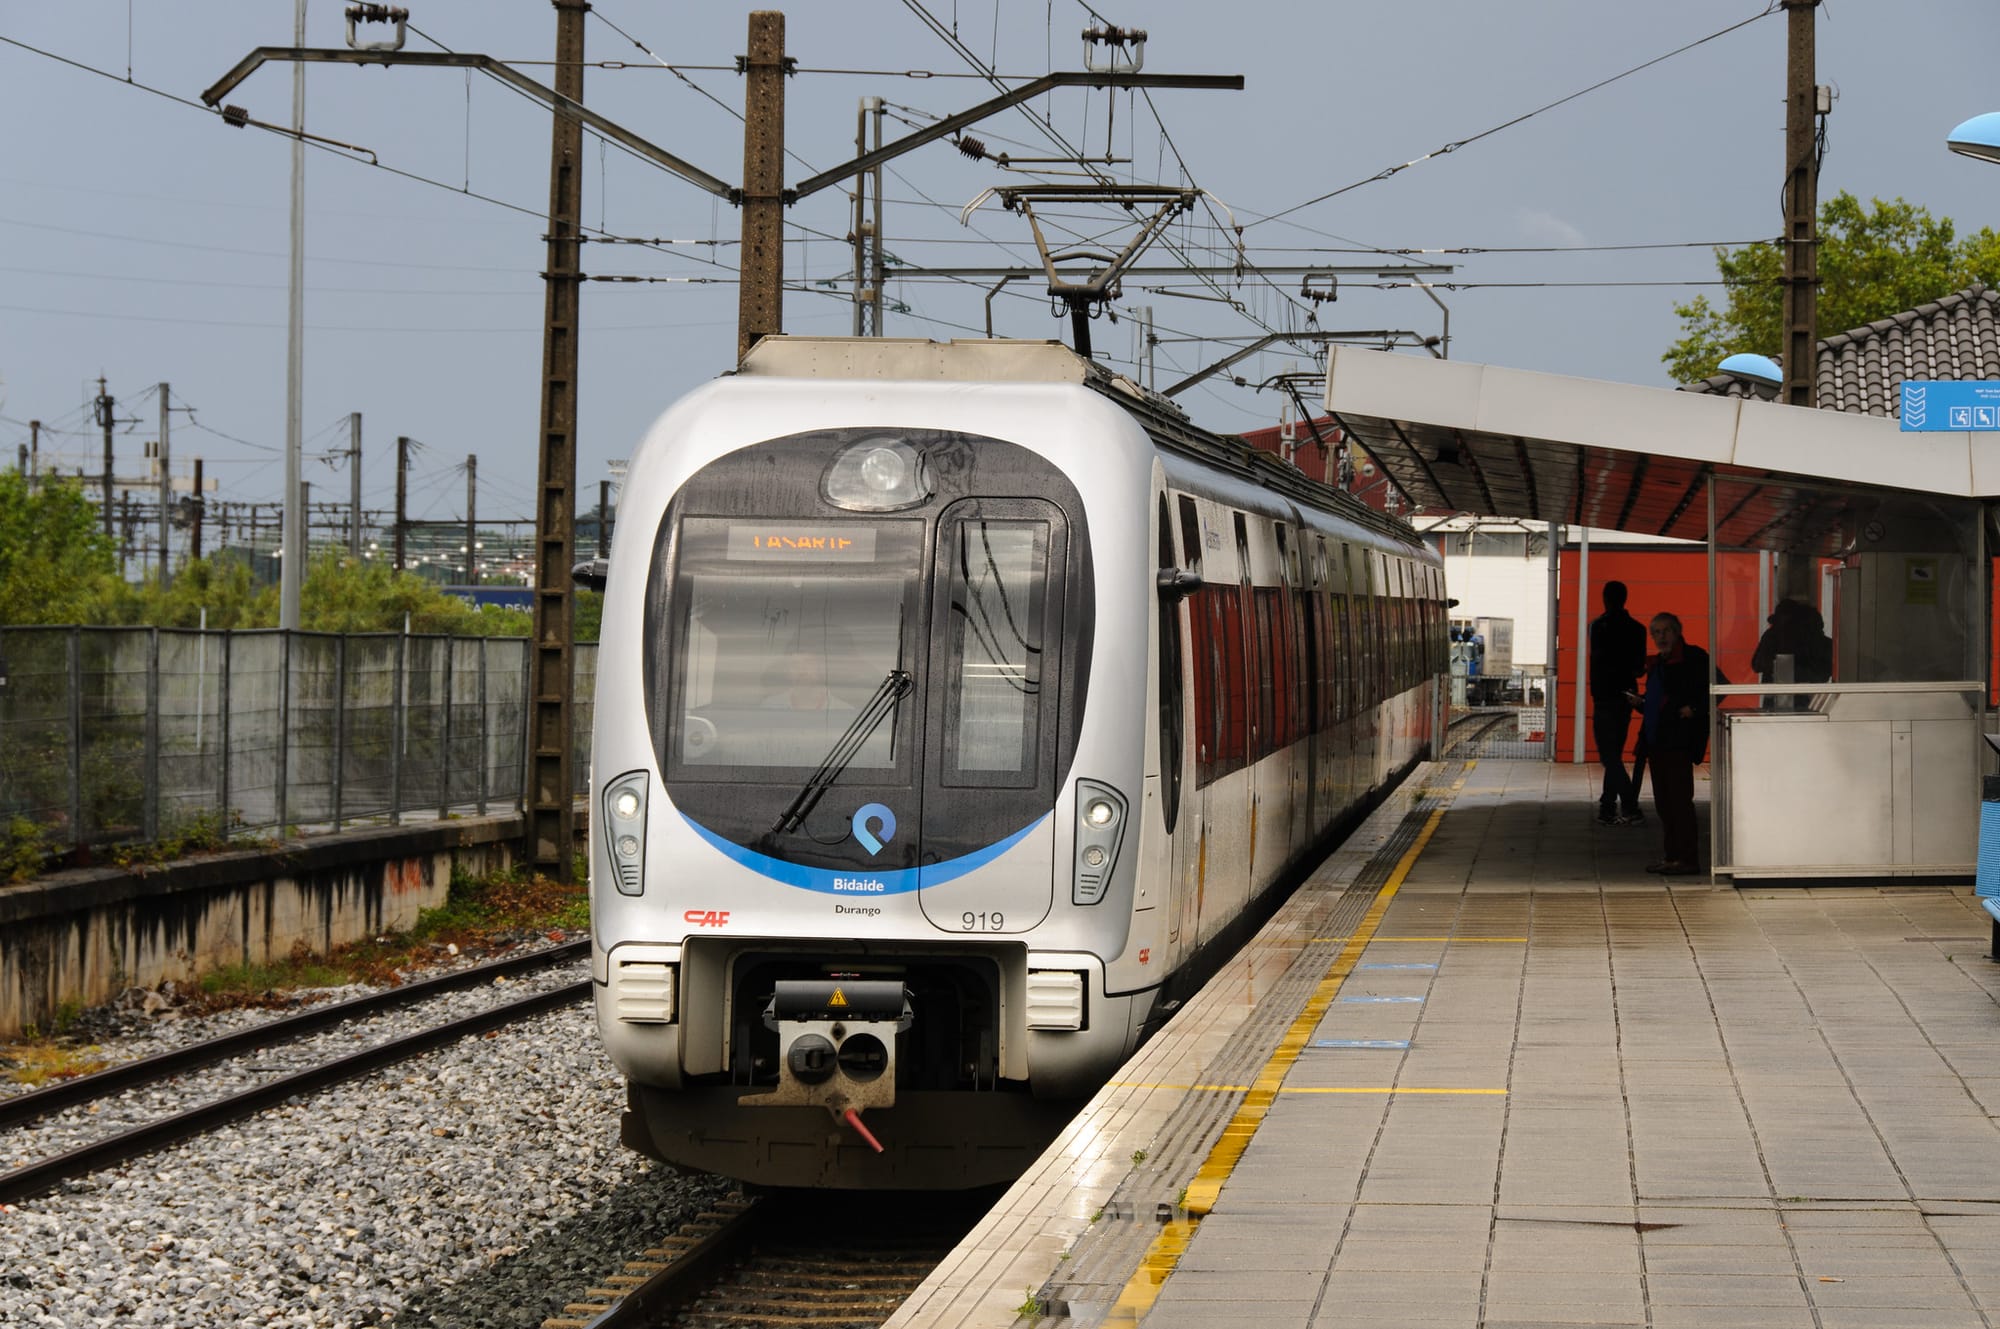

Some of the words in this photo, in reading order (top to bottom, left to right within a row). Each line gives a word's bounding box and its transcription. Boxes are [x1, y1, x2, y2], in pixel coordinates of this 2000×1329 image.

[833, 878, 885, 892] Bidaide
[684, 910, 730, 927] CAF
[835, 905, 881, 917] Durango
[962, 911, 1004, 931] 919
